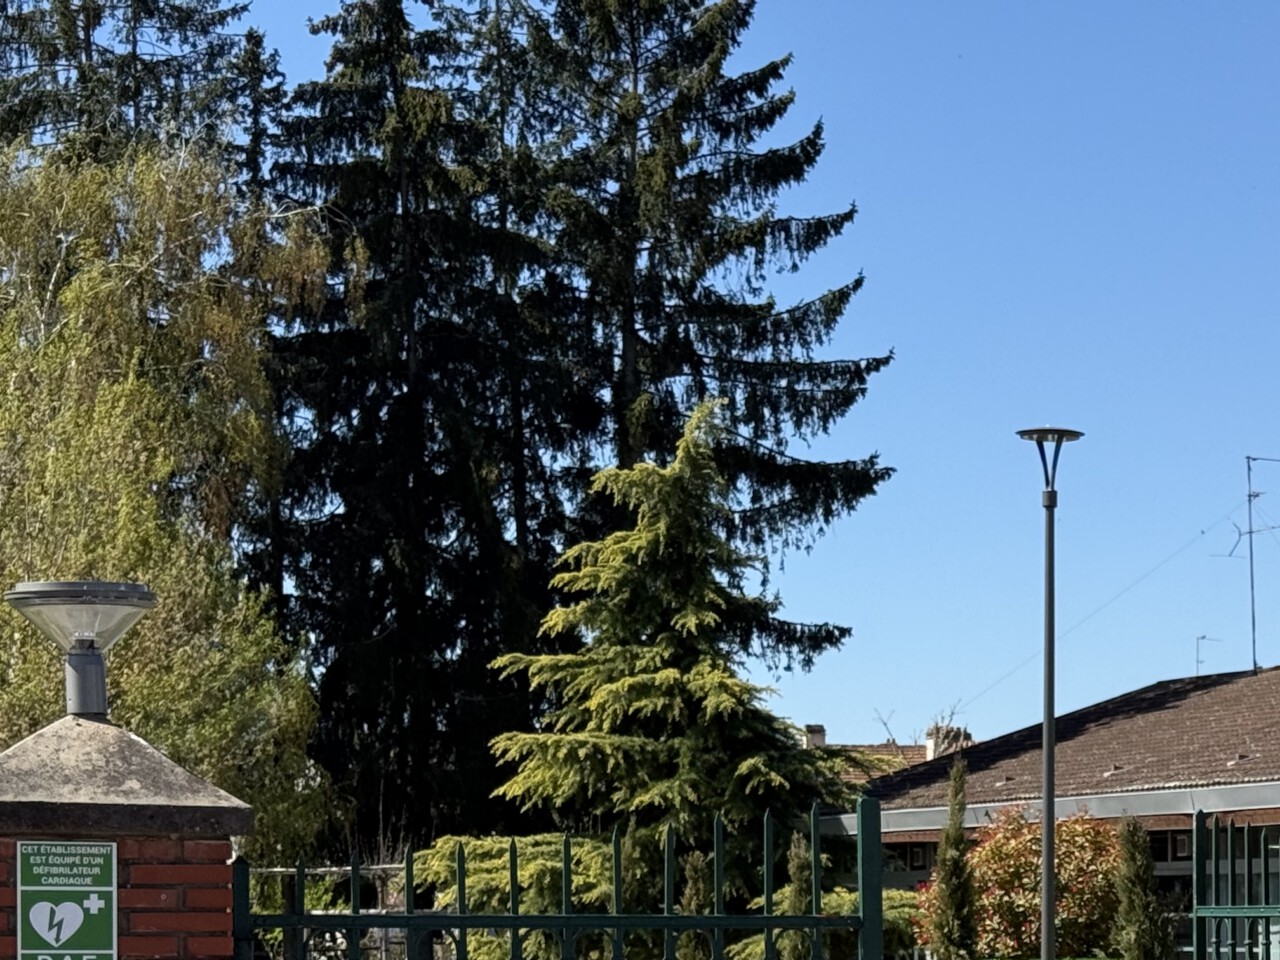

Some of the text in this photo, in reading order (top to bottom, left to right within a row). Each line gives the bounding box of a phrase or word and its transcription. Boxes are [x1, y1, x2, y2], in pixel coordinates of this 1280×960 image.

[41, 845, 111, 854] ÉTABLISSEMENT
[30, 856, 46, 864] EST
[48, 856, 81, 864] ÉQUIPÉ
[33, 866, 100, 874] DÉFIBRILATEUR
